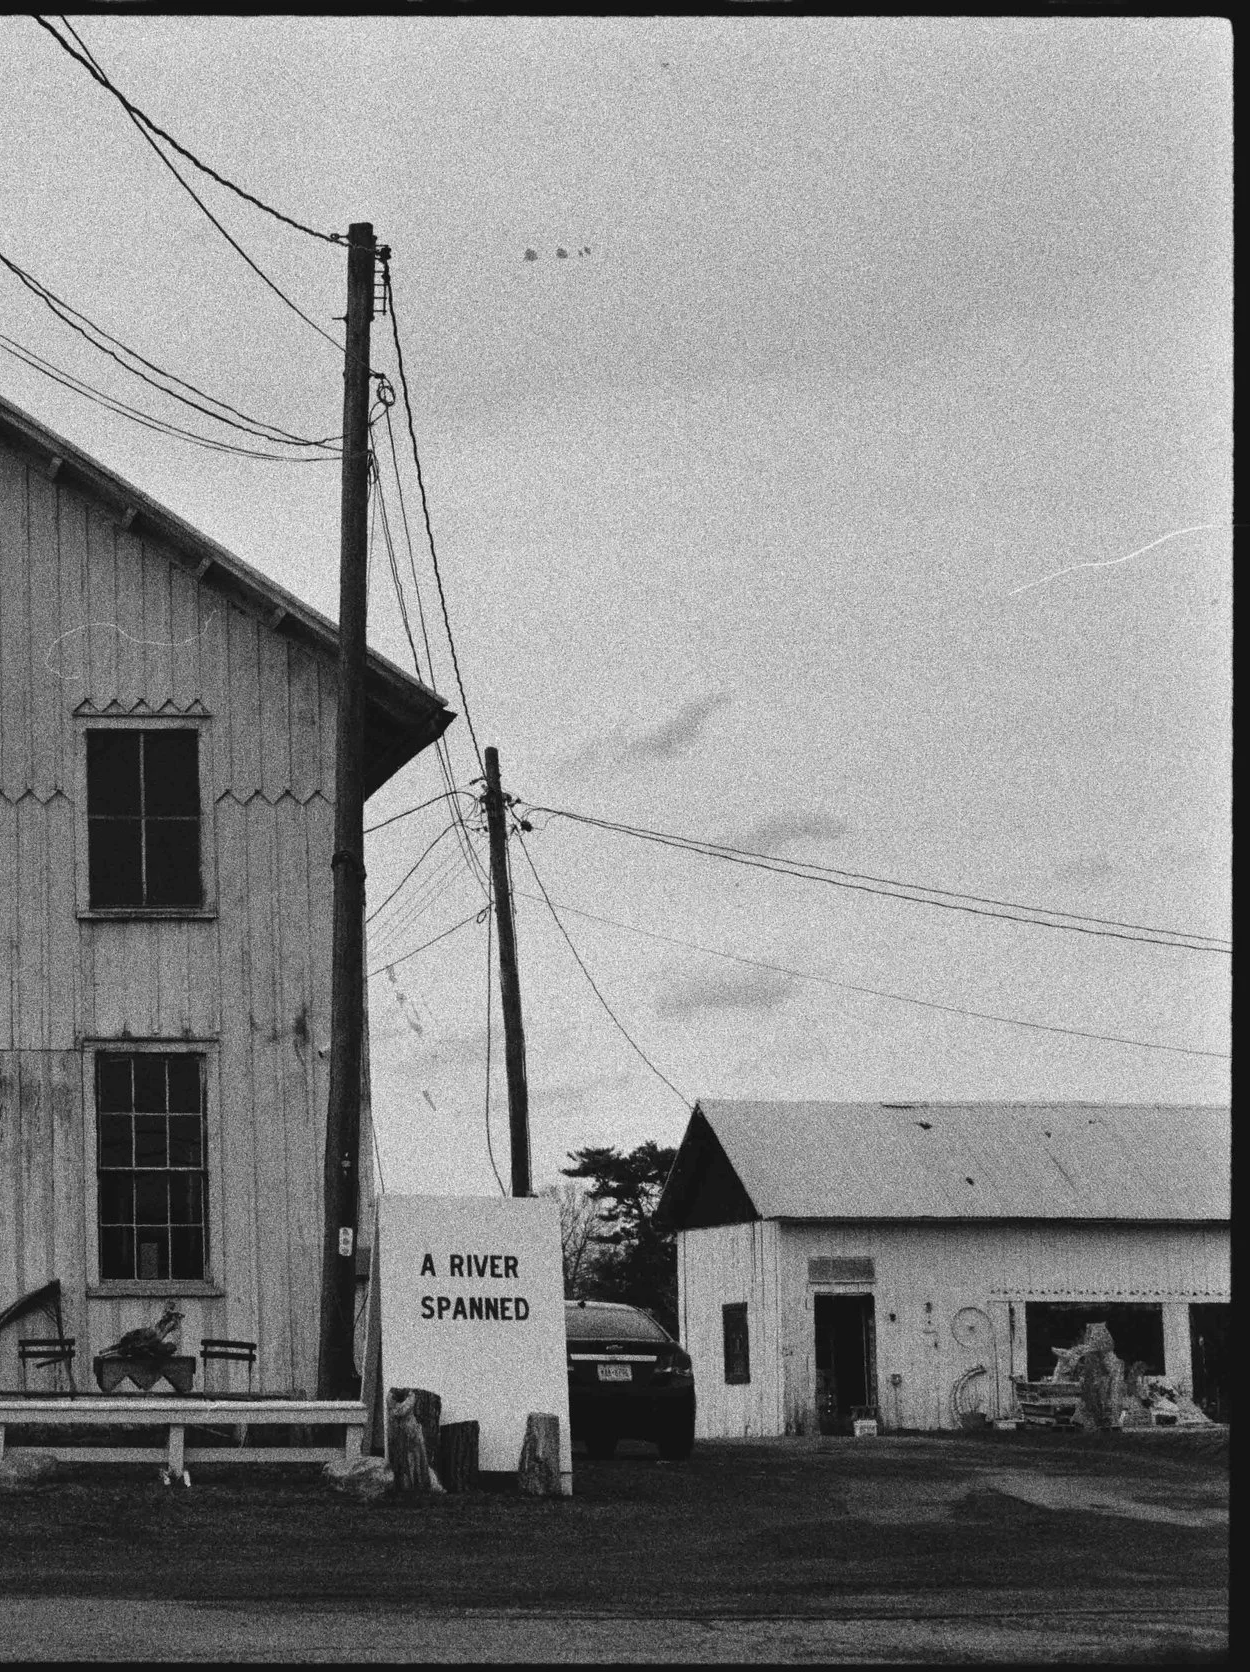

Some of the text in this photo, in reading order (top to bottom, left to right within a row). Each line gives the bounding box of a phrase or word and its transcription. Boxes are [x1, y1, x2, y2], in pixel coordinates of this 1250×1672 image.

[420, 1253, 519, 1278] A RIVER
[421, 1296, 530, 1320] SPANNED
